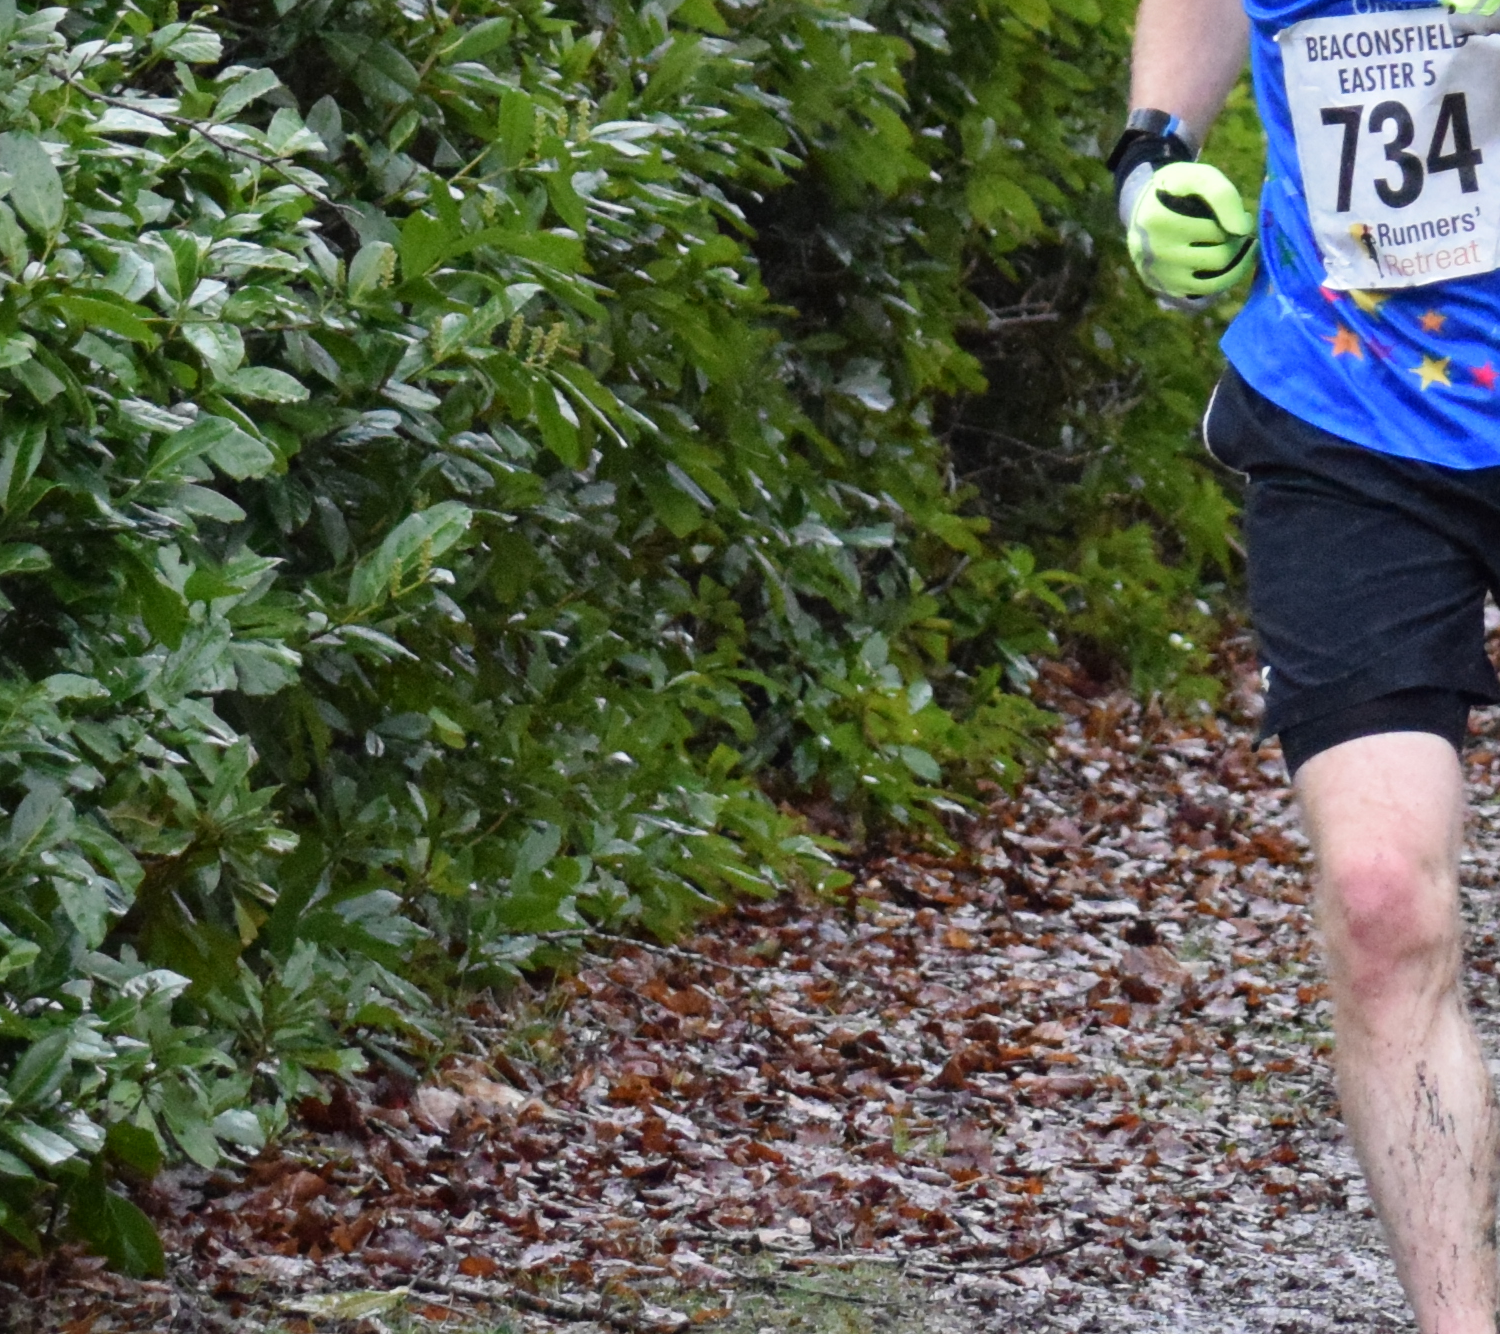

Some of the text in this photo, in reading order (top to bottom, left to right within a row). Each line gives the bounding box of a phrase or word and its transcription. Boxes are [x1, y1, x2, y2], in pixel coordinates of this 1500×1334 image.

[1305, 23, 1469, 63] BEACONSFIELD
[1338, 59, 1436, 94] EASTER 5
[1320, 92, 1483, 213] 734
[1376, 206, 1482, 248] Runners'
[1383, 239, 1482, 277] Retreat
